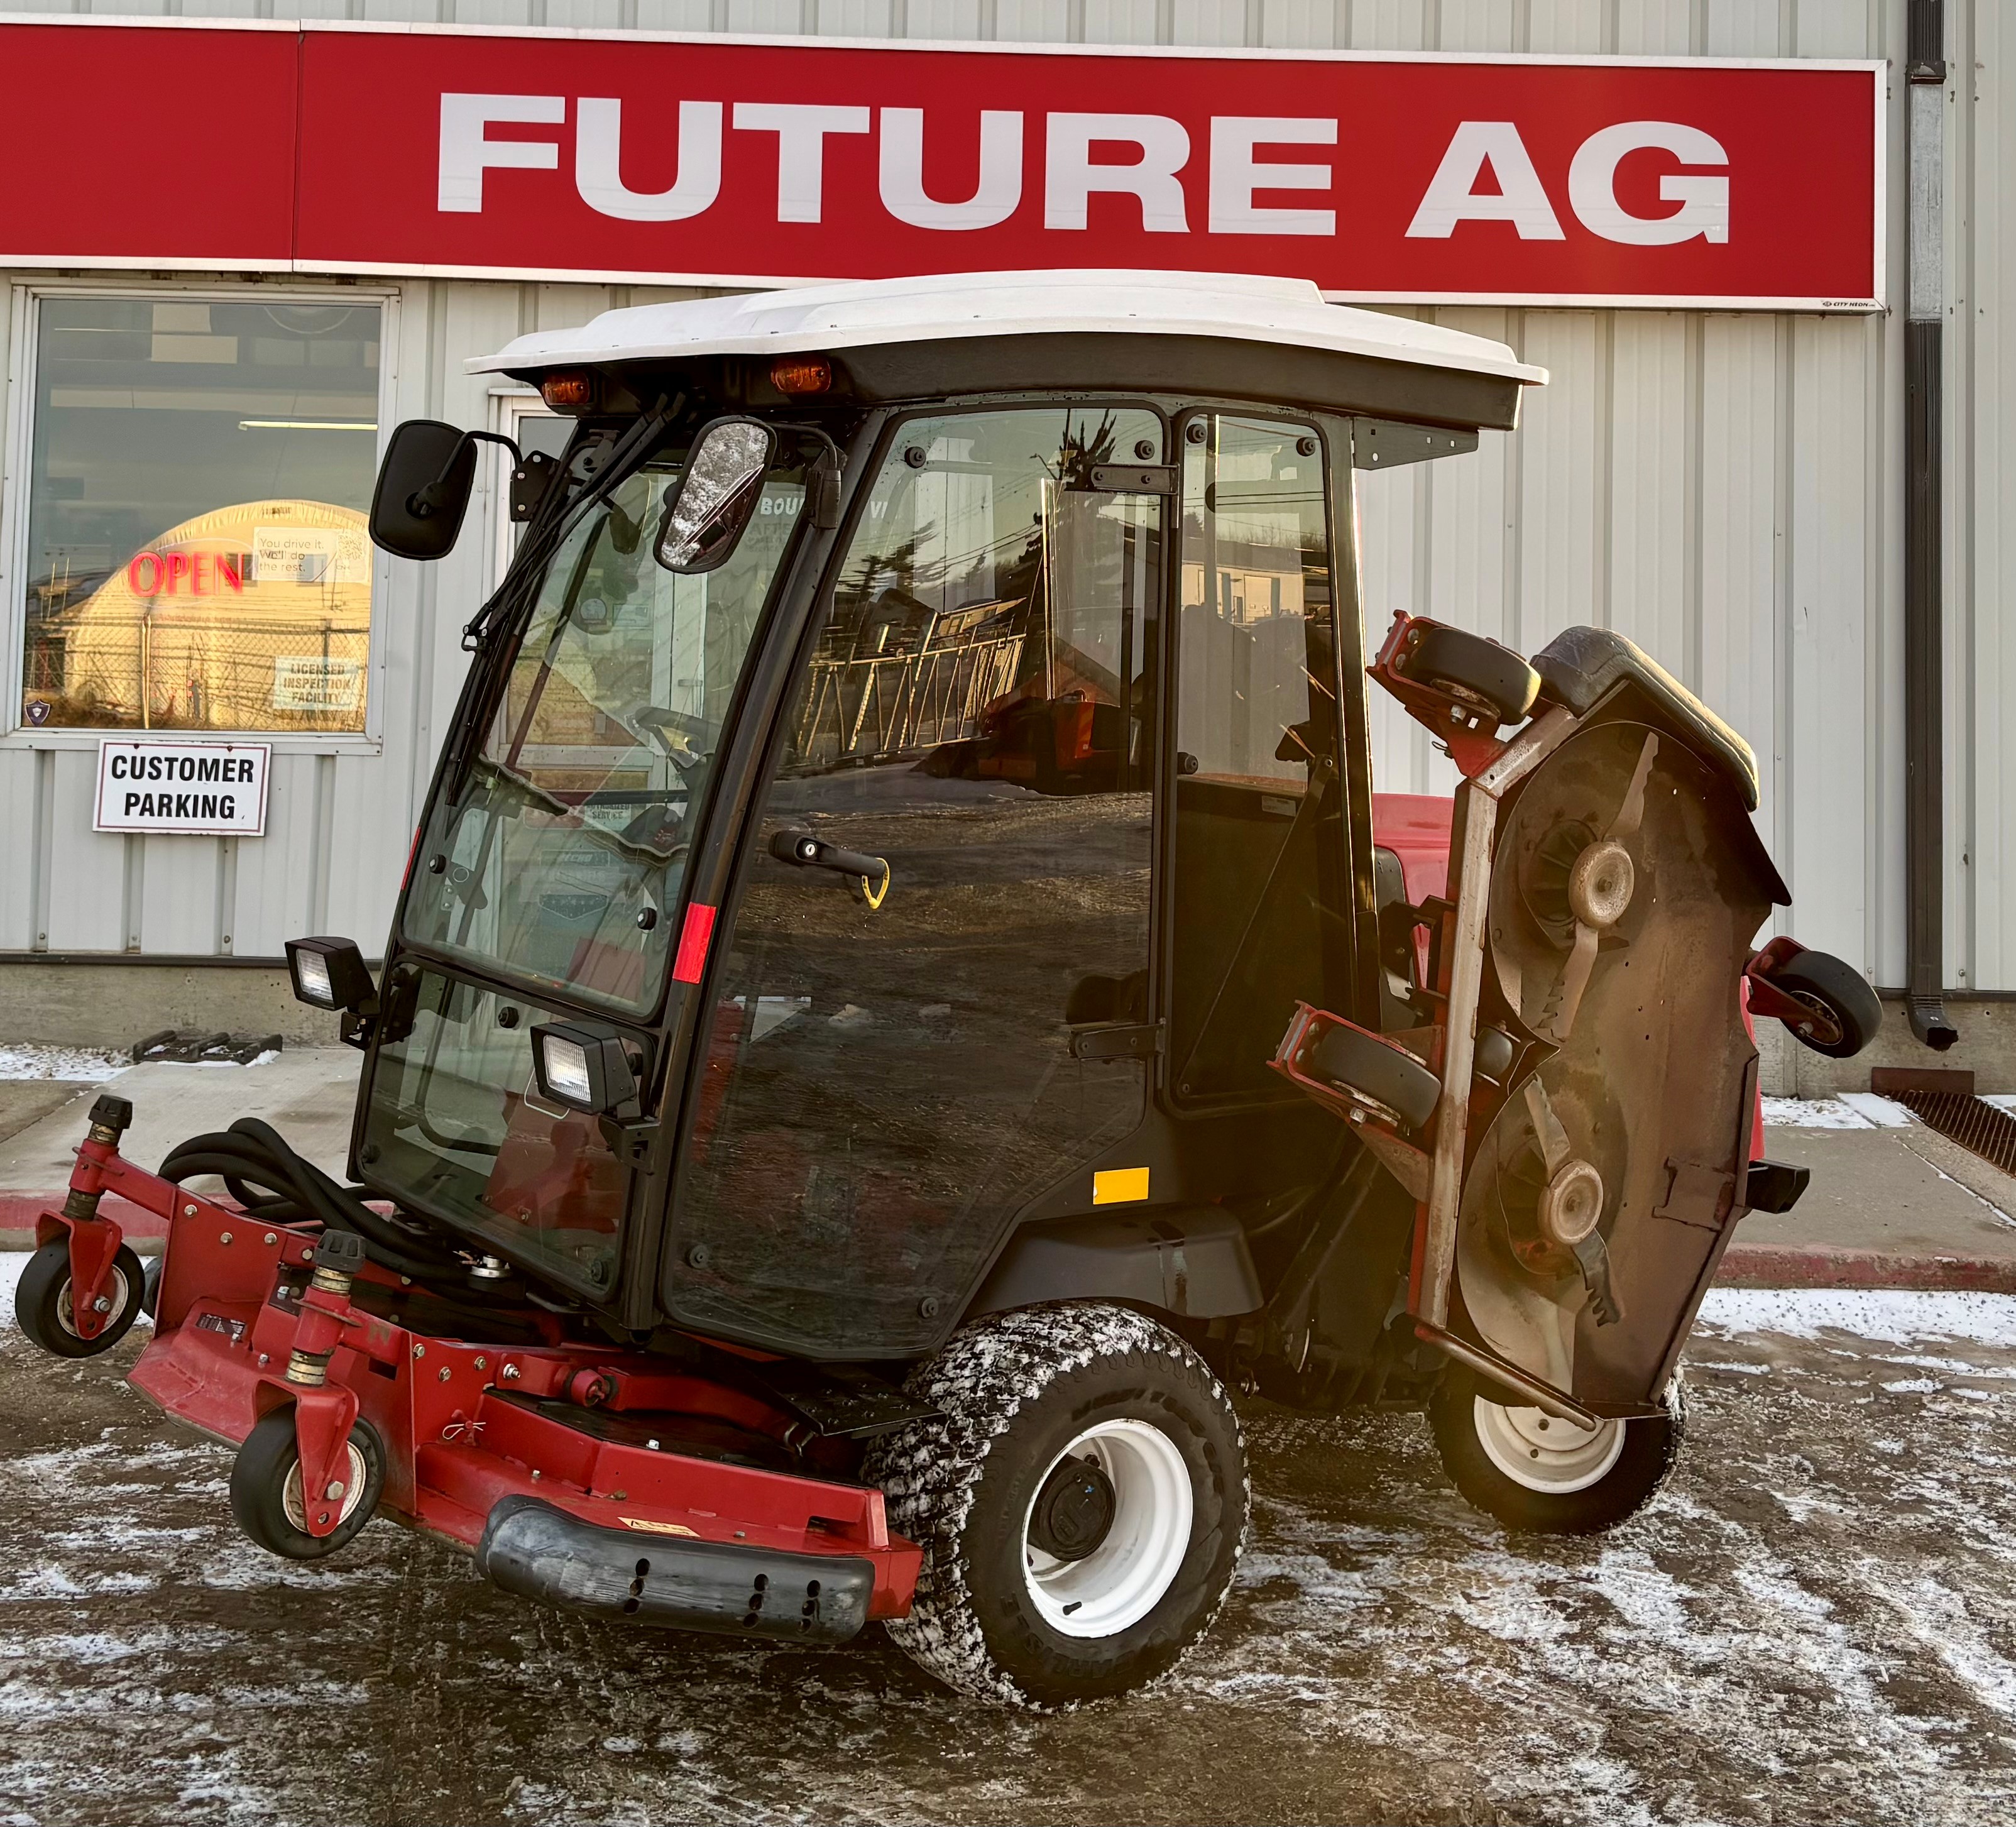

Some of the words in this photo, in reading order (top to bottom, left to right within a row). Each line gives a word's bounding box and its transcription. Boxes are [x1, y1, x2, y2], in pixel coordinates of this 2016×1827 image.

[437, 92, 1339, 236] FUTURE
[1404, 121, 1730, 246] AG
[260, 538, 280, 548] You
[283, 539, 310, 549] drive
[260, 550, 287, 560] We'll
[290, 551, 305, 560] do
[260, 562, 277, 571] the
[282, 563, 305, 572] rest.
[128, 551, 243, 598] OPEN
[291, 664, 345, 675] LICENSED
[283, 678, 351, 689] INSPECTION
[292, 692, 340, 703] FACILITY
[111, 755, 255, 783] CUSTOMER
[124, 793, 235, 820] PARKING
[592, 810, 623, 820] SERVICE
